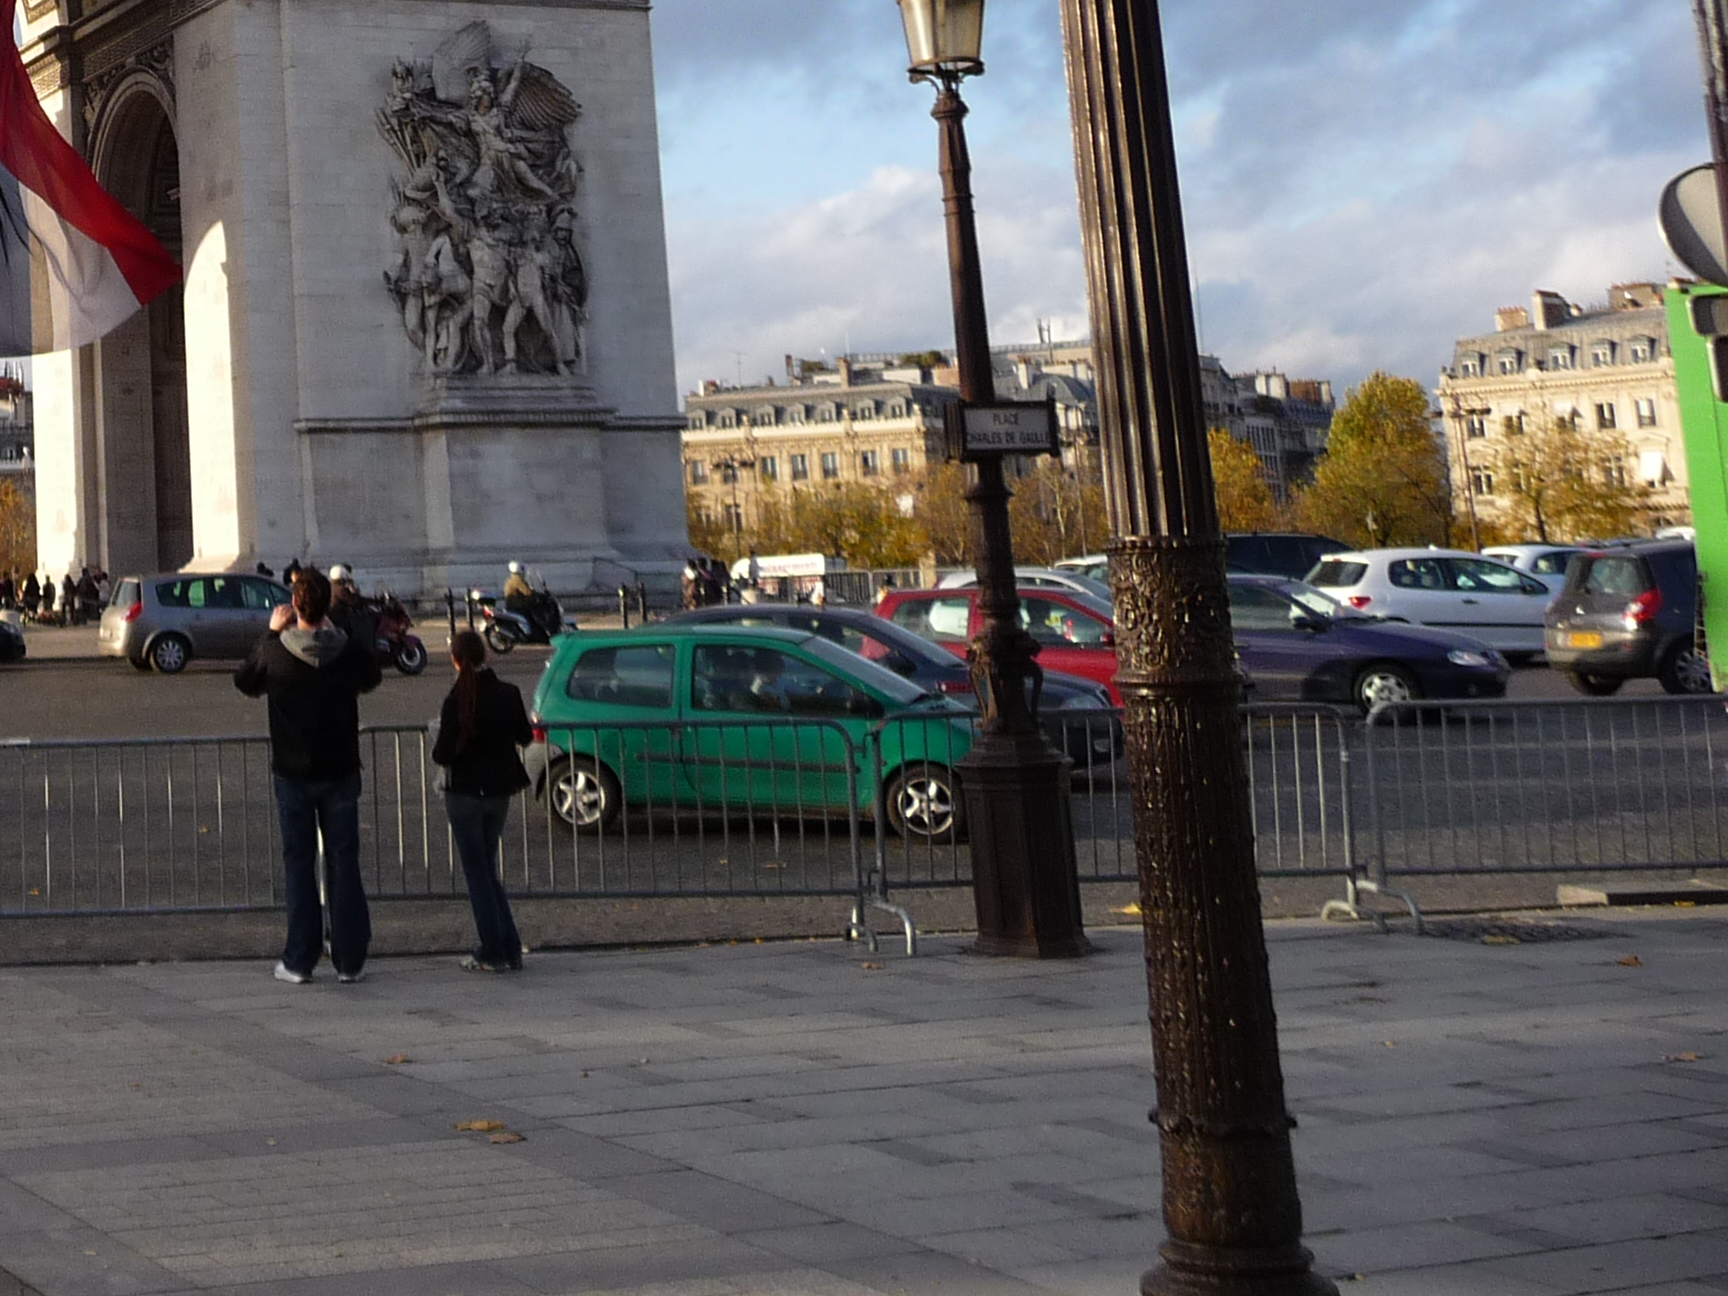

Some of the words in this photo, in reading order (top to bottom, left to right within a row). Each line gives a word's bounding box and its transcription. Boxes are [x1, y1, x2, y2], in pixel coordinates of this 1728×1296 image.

[993, 413, 1019, 426] PLACE
[1005, 431, 1015, 444] DE
[1019, 431, 1051, 445] GAULLE
